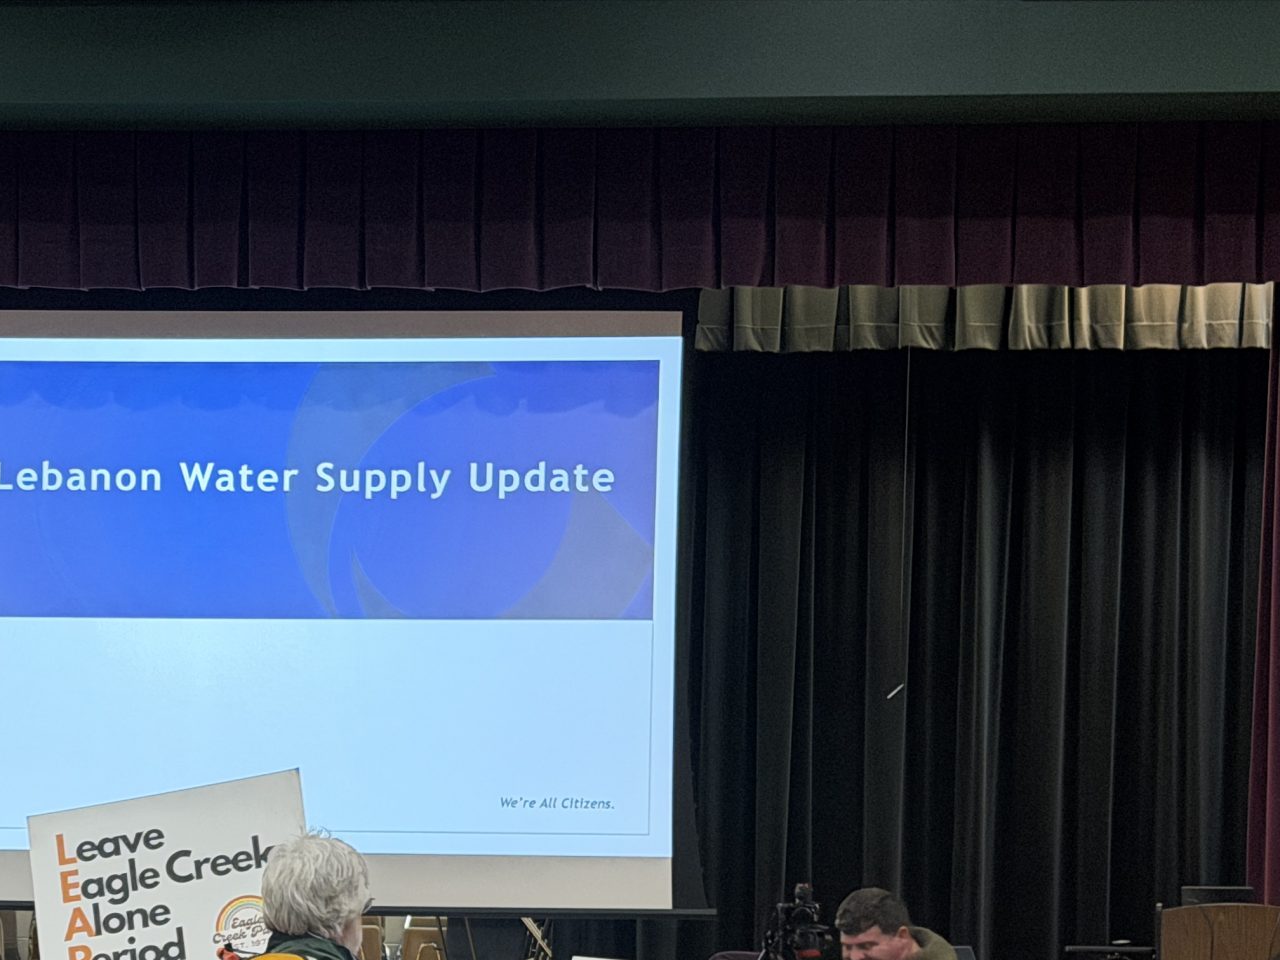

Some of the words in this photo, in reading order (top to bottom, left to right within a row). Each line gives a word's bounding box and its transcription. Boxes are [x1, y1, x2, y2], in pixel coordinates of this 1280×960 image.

[179, 462, 299, 492] Water
[315, 461, 451, 499] Supply
[469, 461, 615, 499] Update
[500, 796, 537, 809] We're
[539, 797, 557, 809] All
[560, 797, 615, 810] Citizens.
[55, 828, 165, 866] Leave
[60, 857, 161, 905] Eagle
[165, 834, 276, 884] Creek
[64, 902, 171, 942] Alone
[212, 928, 247, 944] Creek
